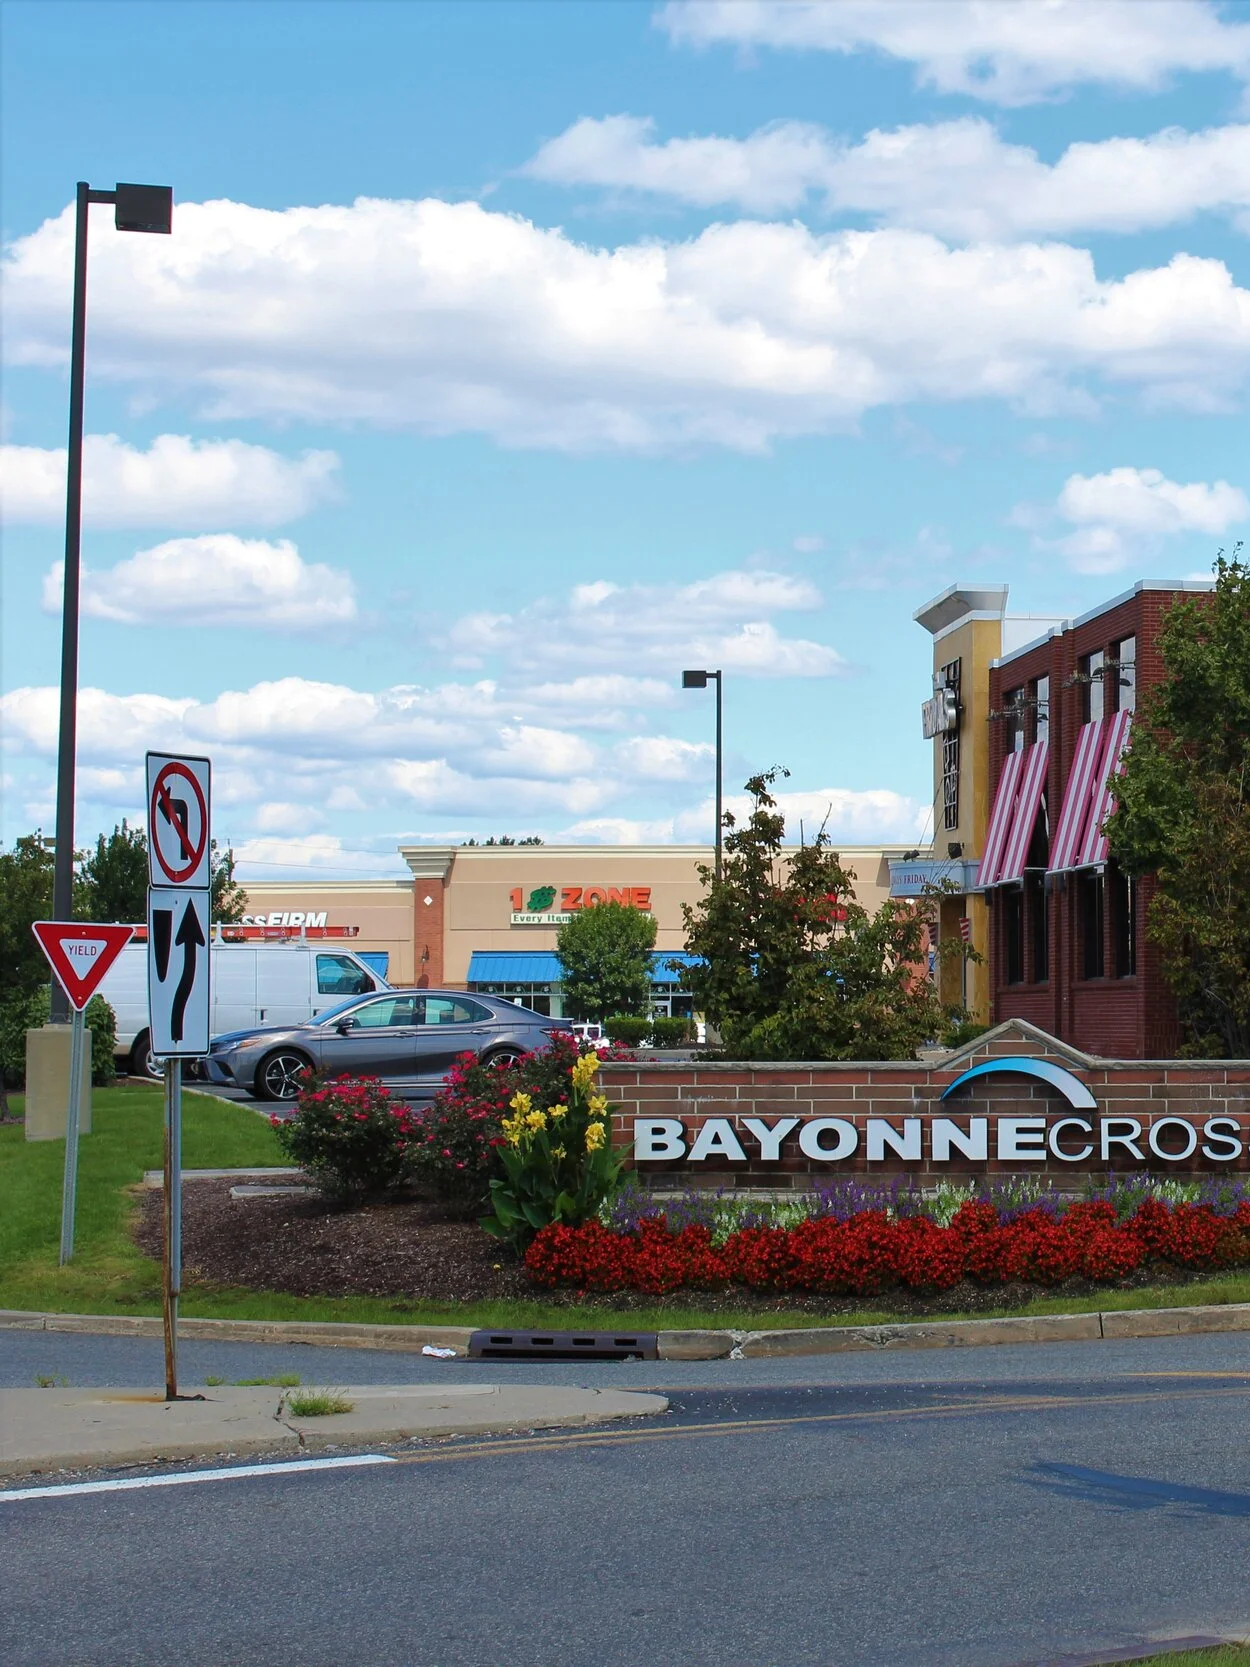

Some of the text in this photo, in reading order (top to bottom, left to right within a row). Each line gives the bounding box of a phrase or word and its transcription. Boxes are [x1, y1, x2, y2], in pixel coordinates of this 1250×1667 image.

[560, 887, 652, 911] ZONE
[513, 914, 543, 923] Every
[68, 945, 97, 956] YIELD
